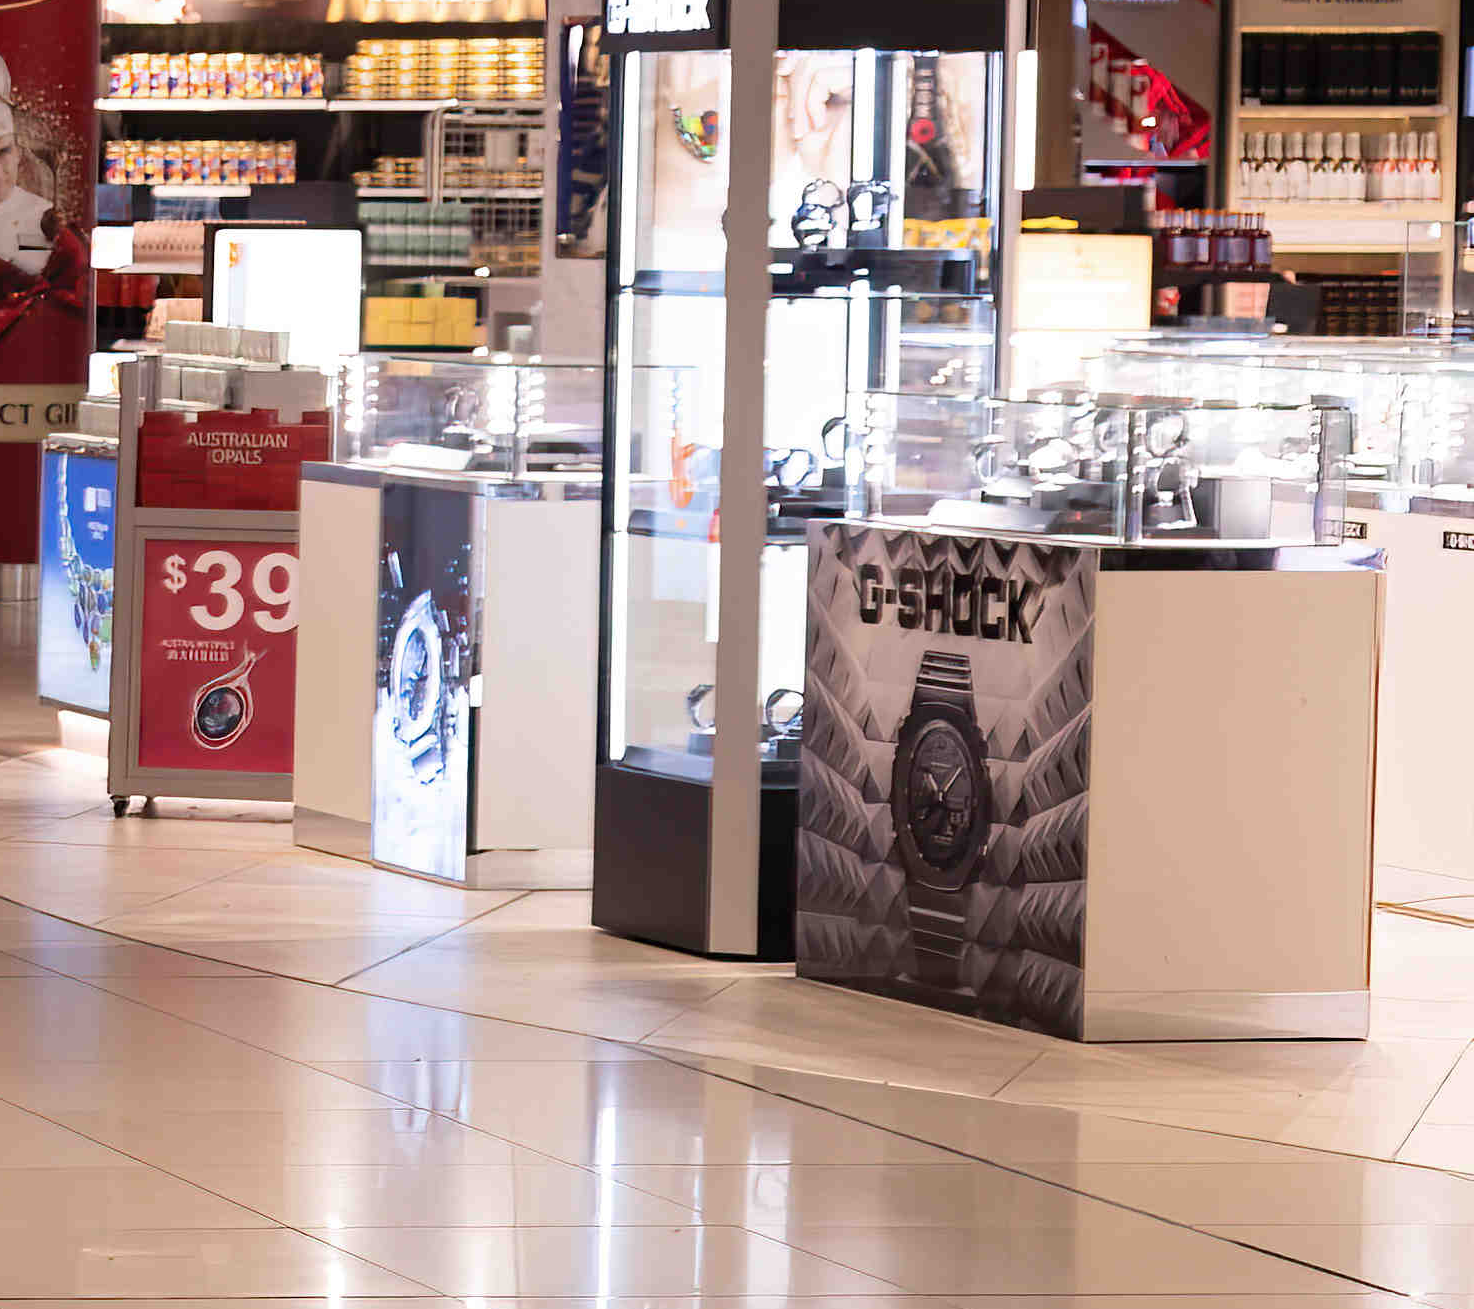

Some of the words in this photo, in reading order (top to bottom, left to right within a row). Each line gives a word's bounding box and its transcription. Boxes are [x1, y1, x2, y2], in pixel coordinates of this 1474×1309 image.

[187, 432, 289, 450] AUSTRALIAN
[211, 449, 263, 466] OPALS
[858, 564, 1035, 644] G-SHOCK
